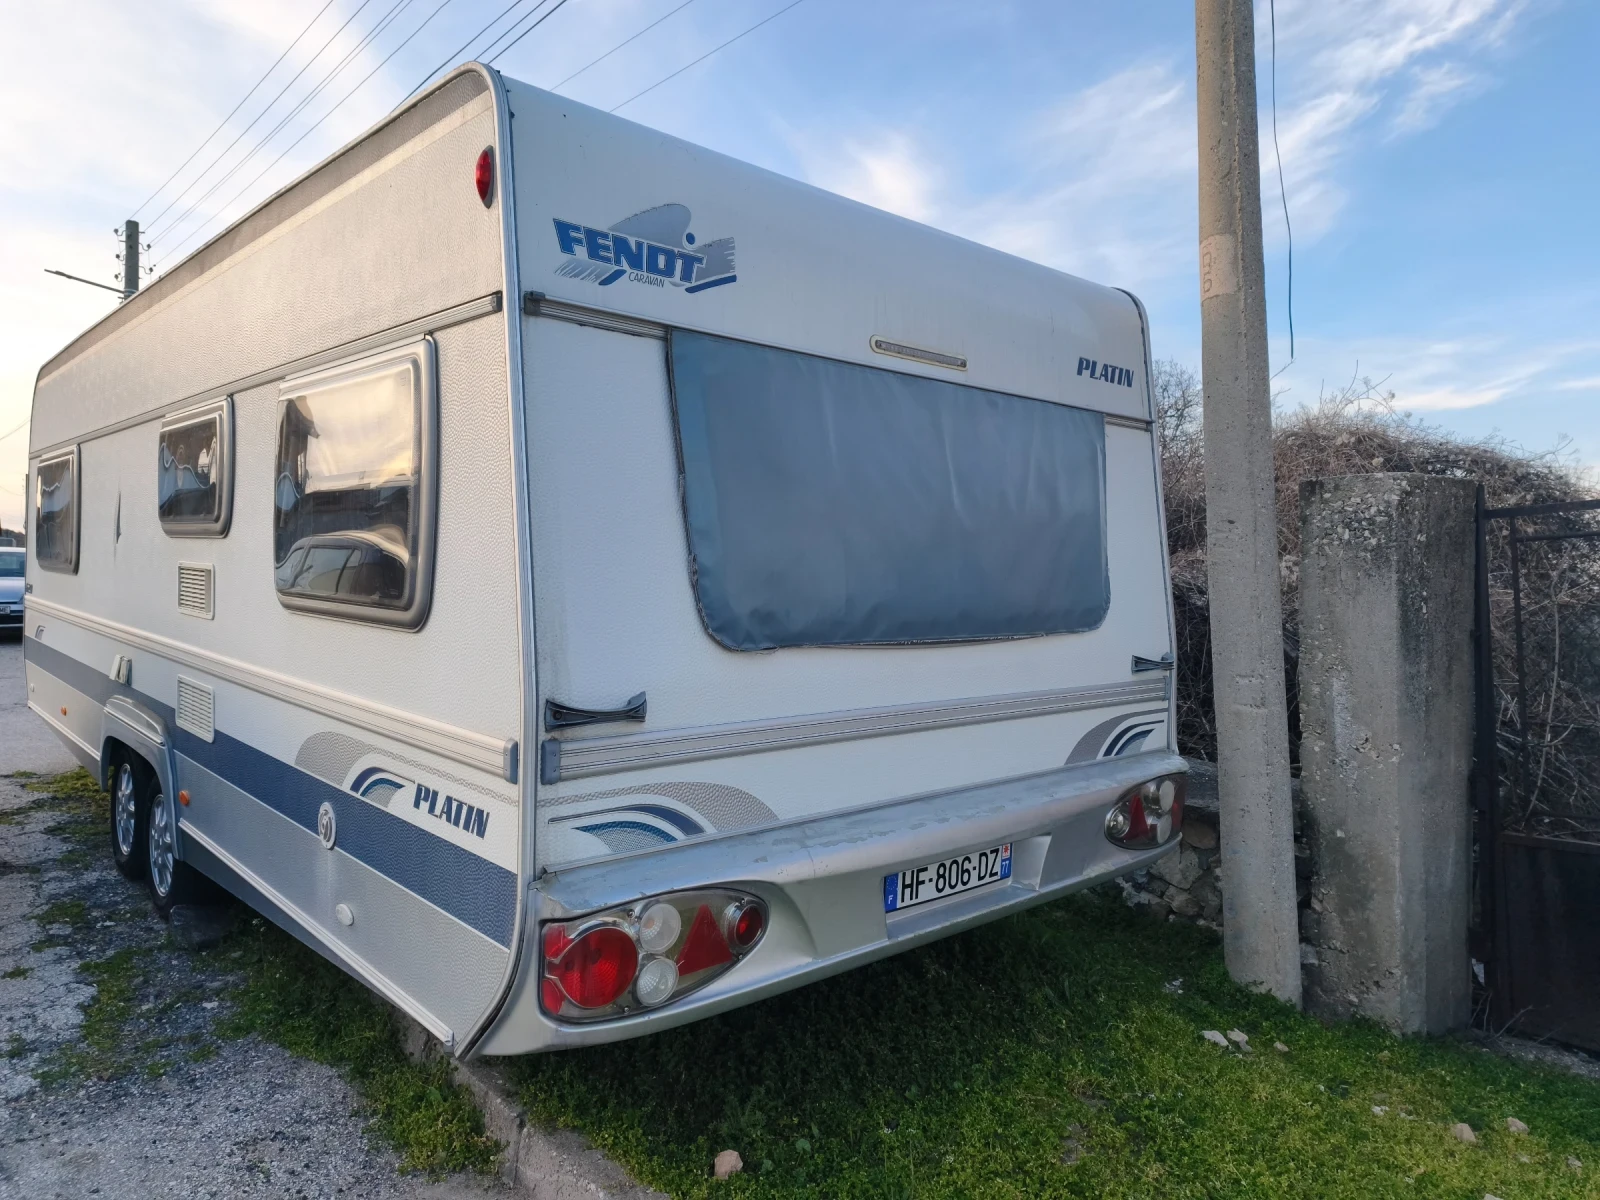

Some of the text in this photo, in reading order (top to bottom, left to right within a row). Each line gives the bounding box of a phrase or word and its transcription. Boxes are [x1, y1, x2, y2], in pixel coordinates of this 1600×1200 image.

[553, 218, 706, 284] FENDT
[628, 271, 665, 288] CARAVAN
[1076, 356, 1134, 388] PLATIN
[413, 783, 490, 840] PLATIN
[900, 847, 1000, 903] HF-806-DZ
[1001, 860, 1010, 875] 77
[888, 894, 894, 905] F
